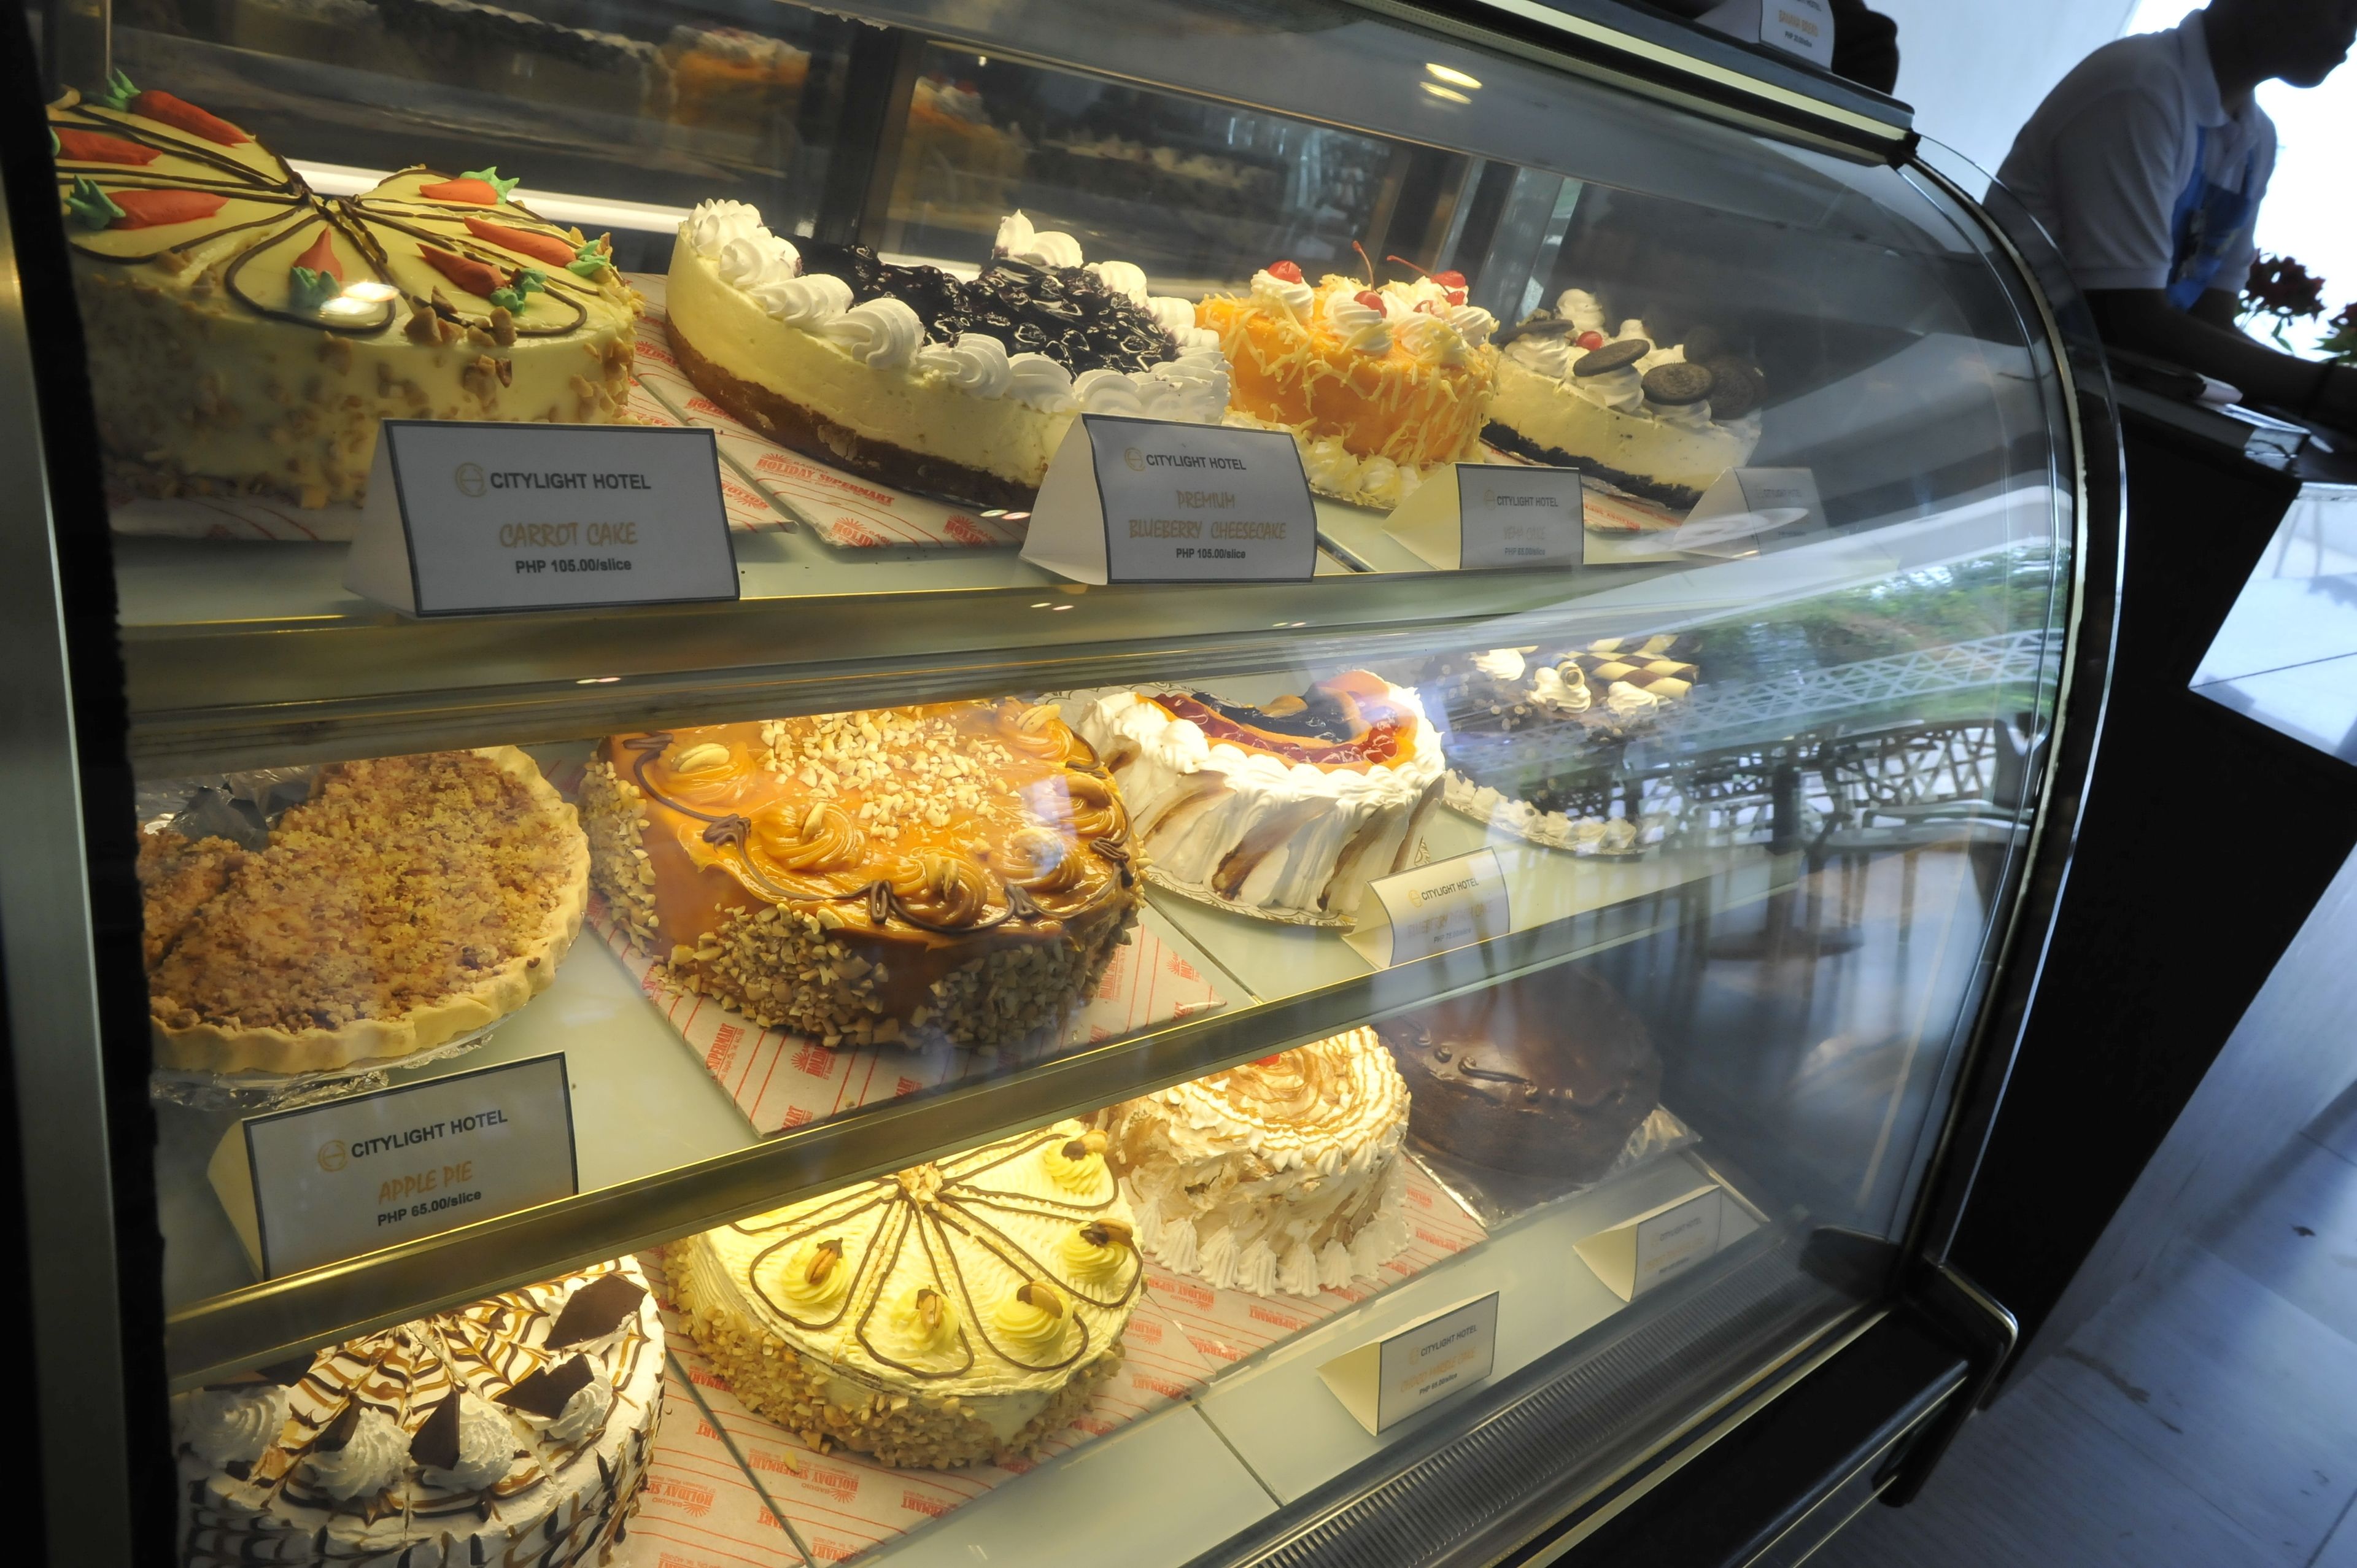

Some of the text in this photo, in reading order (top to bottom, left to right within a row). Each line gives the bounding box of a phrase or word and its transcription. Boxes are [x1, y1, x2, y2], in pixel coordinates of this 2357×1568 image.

[1146, 454, 1247, 470] CITYLIGHT HOTEL
[490, 472, 651, 490] CITYLIGHT HOTEL
[756, 458, 896, 506] HOLIDAY SUPERMART
[1177, 490, 1236, 509] PREMIUM
[1496, 495, 1558, 507] CITYLIGHT HOTEL
[499, 522, 638, 548] CARROT CAKE
[1128, 519, 1287, 540] BLUEBERRY CHEESECAKE
[1175, 548, 1246, 559] PHP 105.00/slice
[515, 558, 632, 574] PHP 105.00/slice
[1421, 878, 1479, 901] CITYLIGHT HOTEL
[706, 1022, 736, 1070] SUPERMART
[351, 1109, 508, 1158] CITYLIGHT HOTEL
[378, 1160, 473, 1205] APPLE PIE
[377, 1189, 482, 1226] PHP 65.00/slice
[1420, 1324, 1477, 1356] CITYLIGHT HOTEL
[1419, 1385, 1431, 1396] PHP
[811, 1471, 859, 1493] HOLIDAY
[652, 1496, 683, 1508] BAGUIO
[664, 1483, 714, 1507] HOLIDAY
